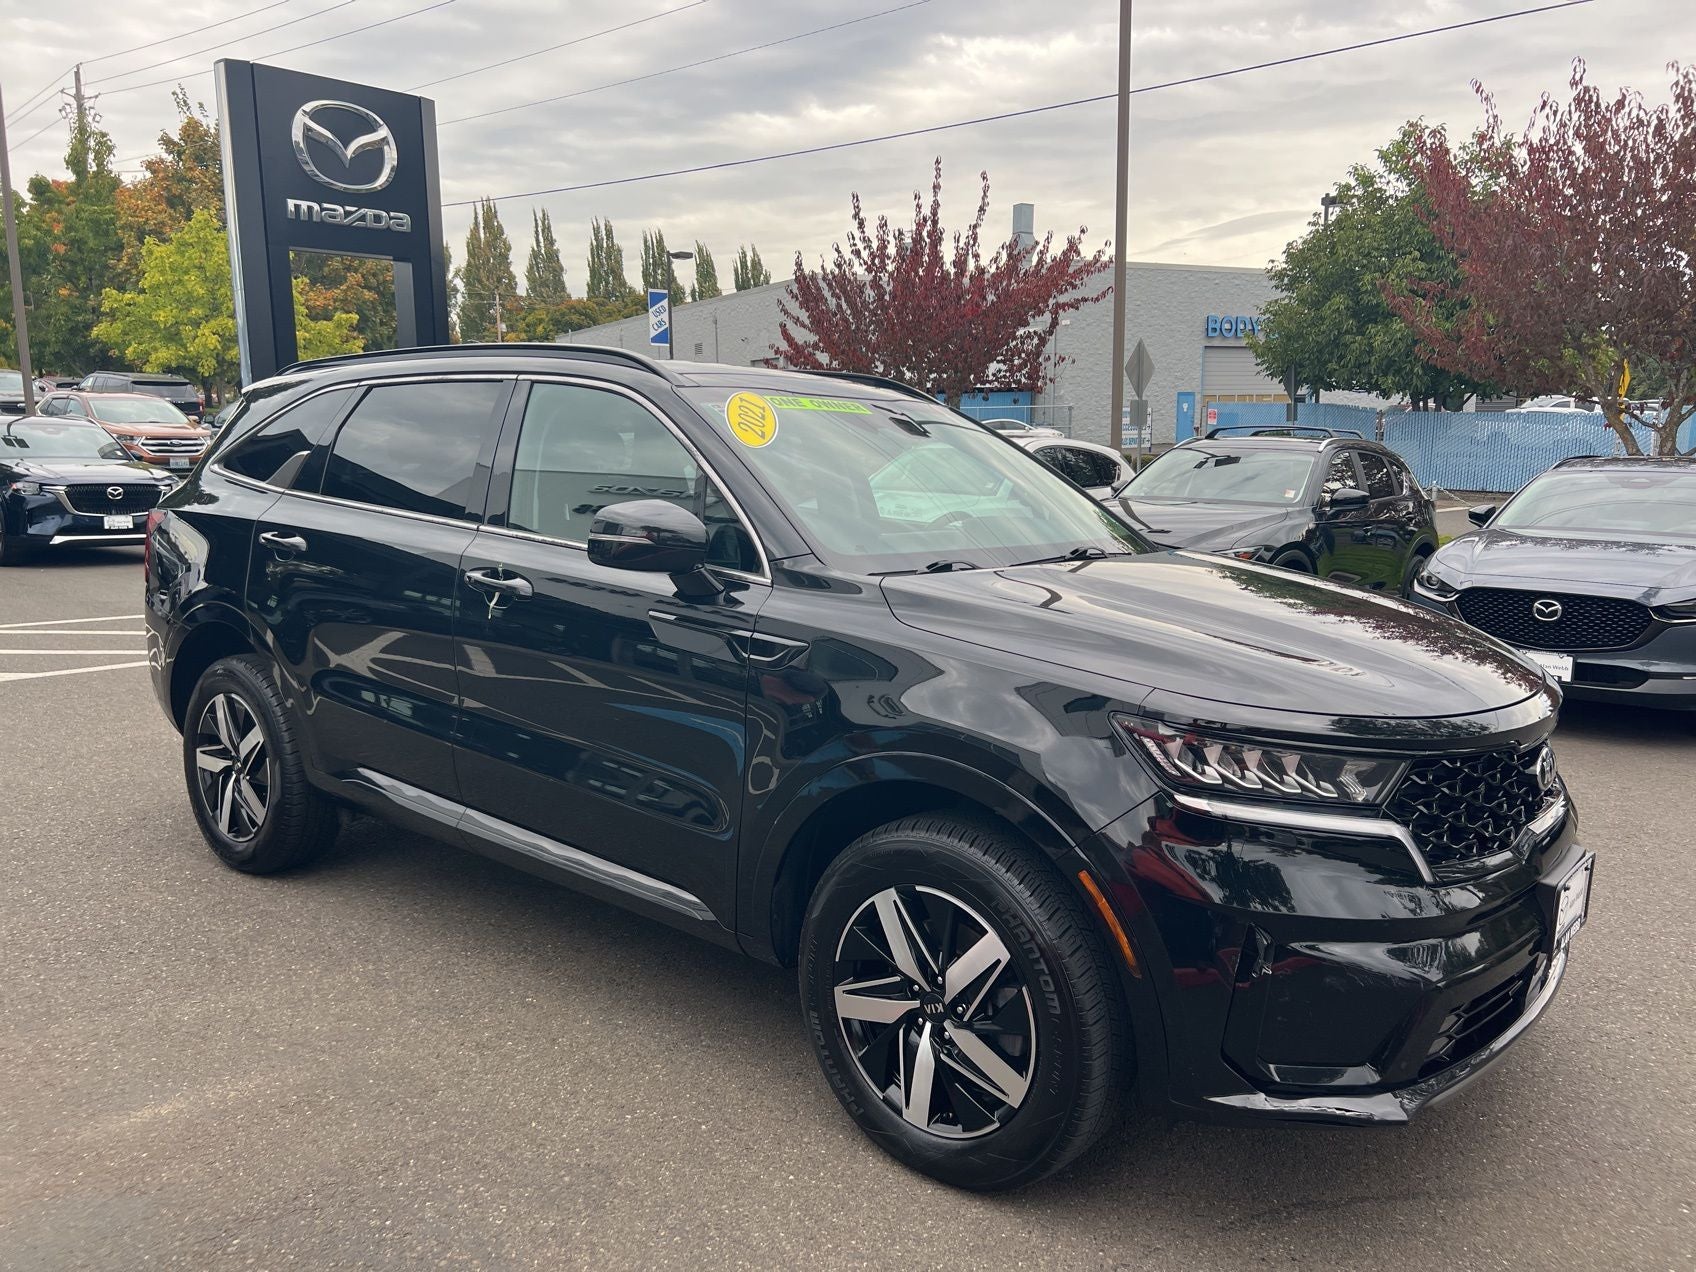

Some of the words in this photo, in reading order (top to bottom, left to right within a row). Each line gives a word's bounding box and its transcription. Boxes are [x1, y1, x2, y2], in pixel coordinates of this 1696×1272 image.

[652, 304, 667, 318] USED
[652, 318, 667, 331] CARS
[1207, 314, 1260, 337] BODY
[769, 397, 804, 408] ONE
[809, 400, 865, 412] OWNER
[738, 396, 766, 440] 2021
[924, 1002, 944, 1014] KIA
